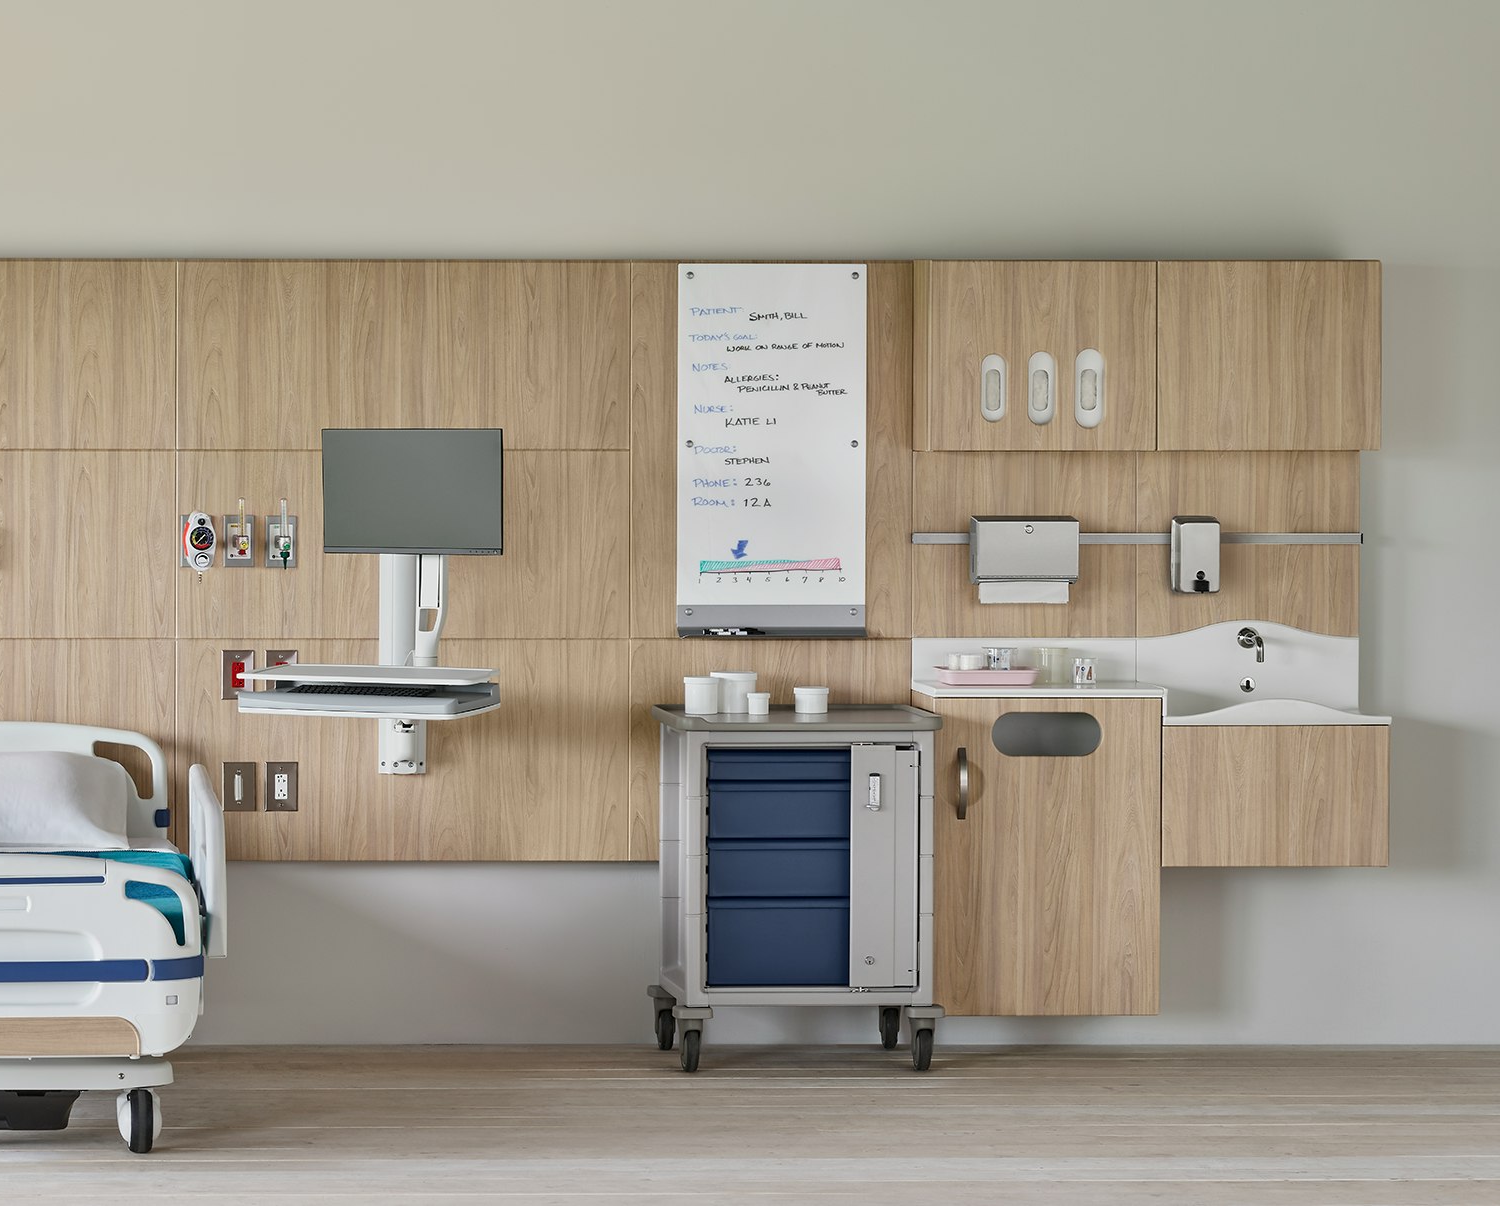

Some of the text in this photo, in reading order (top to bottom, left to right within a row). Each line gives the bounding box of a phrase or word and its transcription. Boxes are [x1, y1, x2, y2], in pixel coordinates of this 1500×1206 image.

[724, 374, 779, 383] ALLERGIES:
[737, 384, 790, 393] PENICILLIN
[725, 417, 760, 428] KATIE
[724, 457, 770, 466] STEPHEN
[692, 477, 771, 488] PHONE: 236
[691, 496, 735, 508] ROOM:
[802, 576, 808, 584] 7
